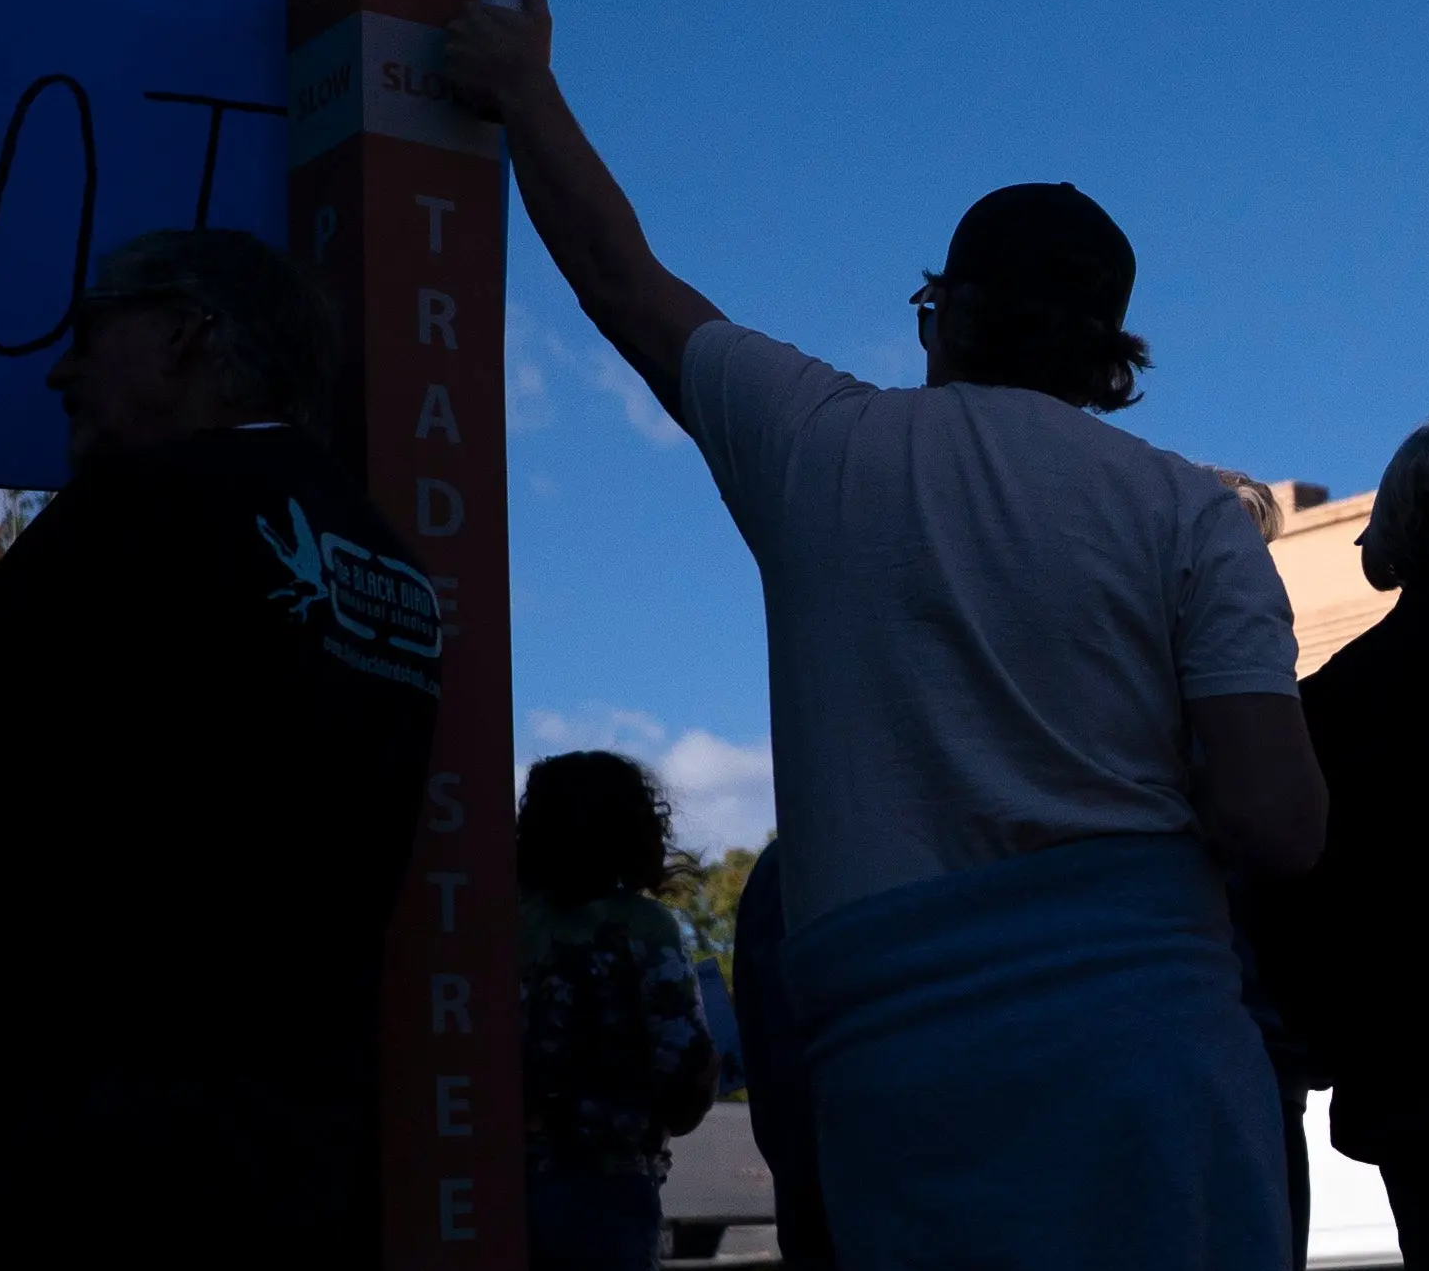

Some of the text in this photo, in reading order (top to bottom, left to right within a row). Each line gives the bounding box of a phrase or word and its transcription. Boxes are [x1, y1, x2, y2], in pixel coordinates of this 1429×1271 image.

[296, 62, 351, 122] SLOW
[382, 61, 467, 107] SLO
[414, 193, 466, 636] TRADE
[352, 564, 397, 603] BLACK
[400, 583, 433, 617] BIRD
